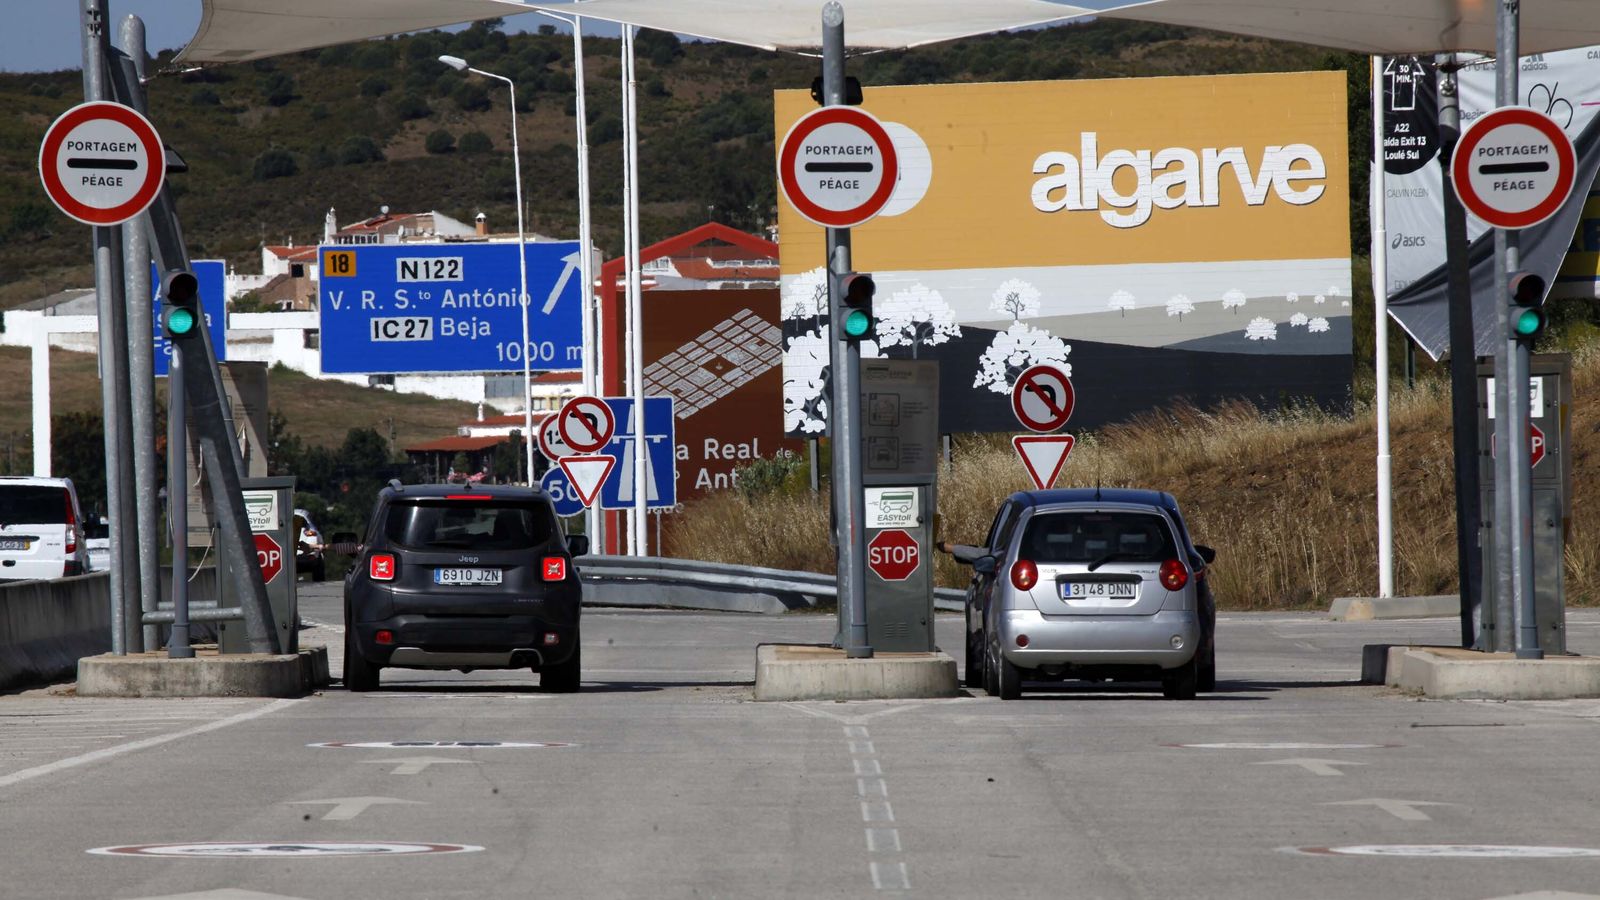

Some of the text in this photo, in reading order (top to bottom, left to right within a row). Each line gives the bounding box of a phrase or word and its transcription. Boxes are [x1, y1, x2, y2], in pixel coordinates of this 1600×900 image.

[1587, 51, 1600, 59] CA
[1399, 65, 1410, 73] 30
[1521, 62, 1548, 72] adidas
[1396, 75, 1412, 83] MIN.
[1394, 123, 1410, 133] A22
[67, 140, 137, 153] PORTAGEM
[1384, 135, 1427, 147] aída Exit 13
[805, 145, 874, 155] PORTAGEM
[1384, 149, 1420, 160] Loulé Sul
[1478, 145, 1549, 157] PORTAGEM
[81, 173, 123, 187] PÉAGE
[819, 177, 860, 190] PÉAGE
[1031, 131, 1327, 229] algarve
[1493, 179, 1535, 192] PÉAGE
[1387, 188, 1410, 198] CALVIN
[1402, 235, 1426, 247] asics
[330, 254, 350, 273] 18
[400, 259, 460, 280] N122
[329, 290, 350, 310] V.
[361, 289, 384, 310] R.
[441, 287, 532, 309] António
[440, 316, 491, 340] Beja
[496, 341, 582, 362] 1000 m
[704, 437, 761, 461] Real
[694, 467, 741, 490] Ant
[550, 480, 581, 501] 50
[256, 550, 280, 568] OP
[458, 555, 479, 564] Jeep
[870, 546, 918, 564] STOP
[443, 569, 499, 582] 6910 JZN
[1072, 583, 1132, 596] 3148 DNN
